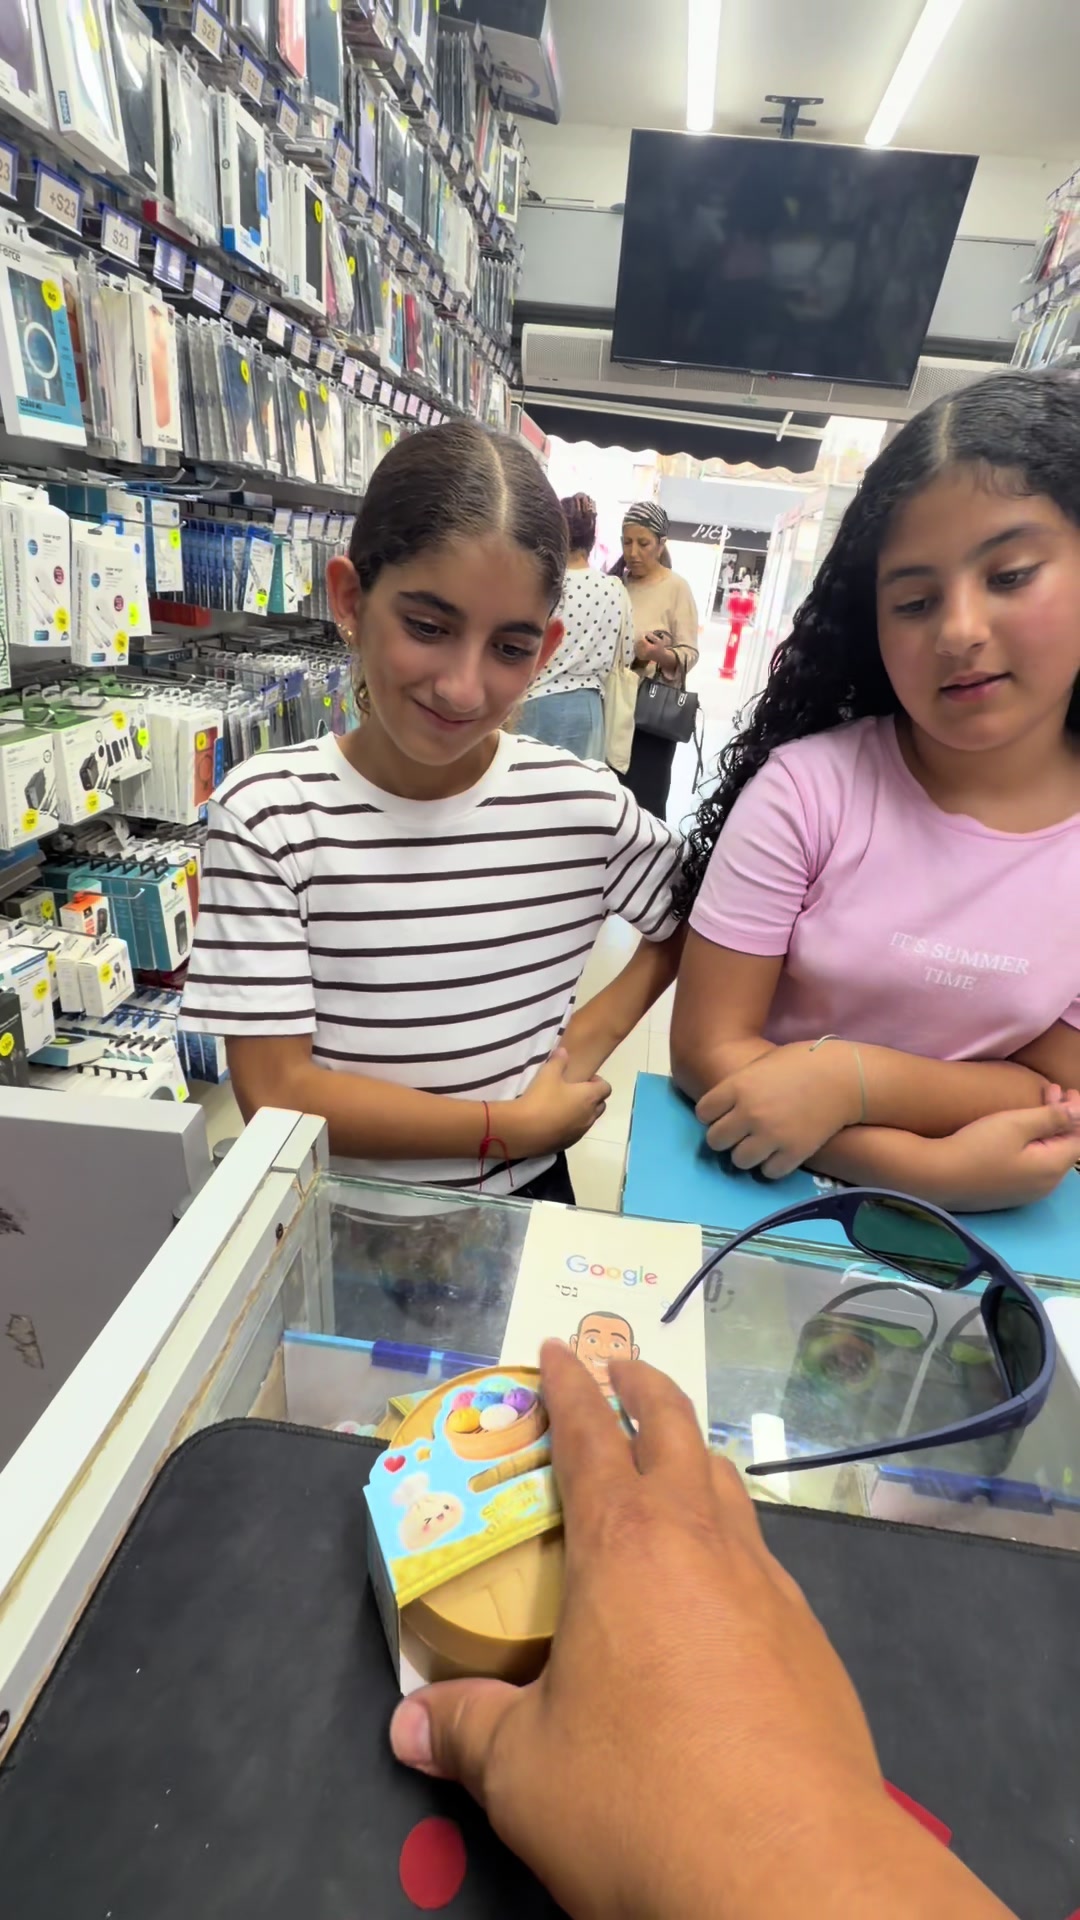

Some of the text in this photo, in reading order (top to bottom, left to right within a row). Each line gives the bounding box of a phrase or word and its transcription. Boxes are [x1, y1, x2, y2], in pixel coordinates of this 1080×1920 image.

[49, 192, 77, 219] +S23
[111, 229, 130, 251] S23
[889, 931, 1030, 974] IT'S SUMMER
[924, 966, 977, 991] TIME
[565, 1254, 658, 1287] Google
